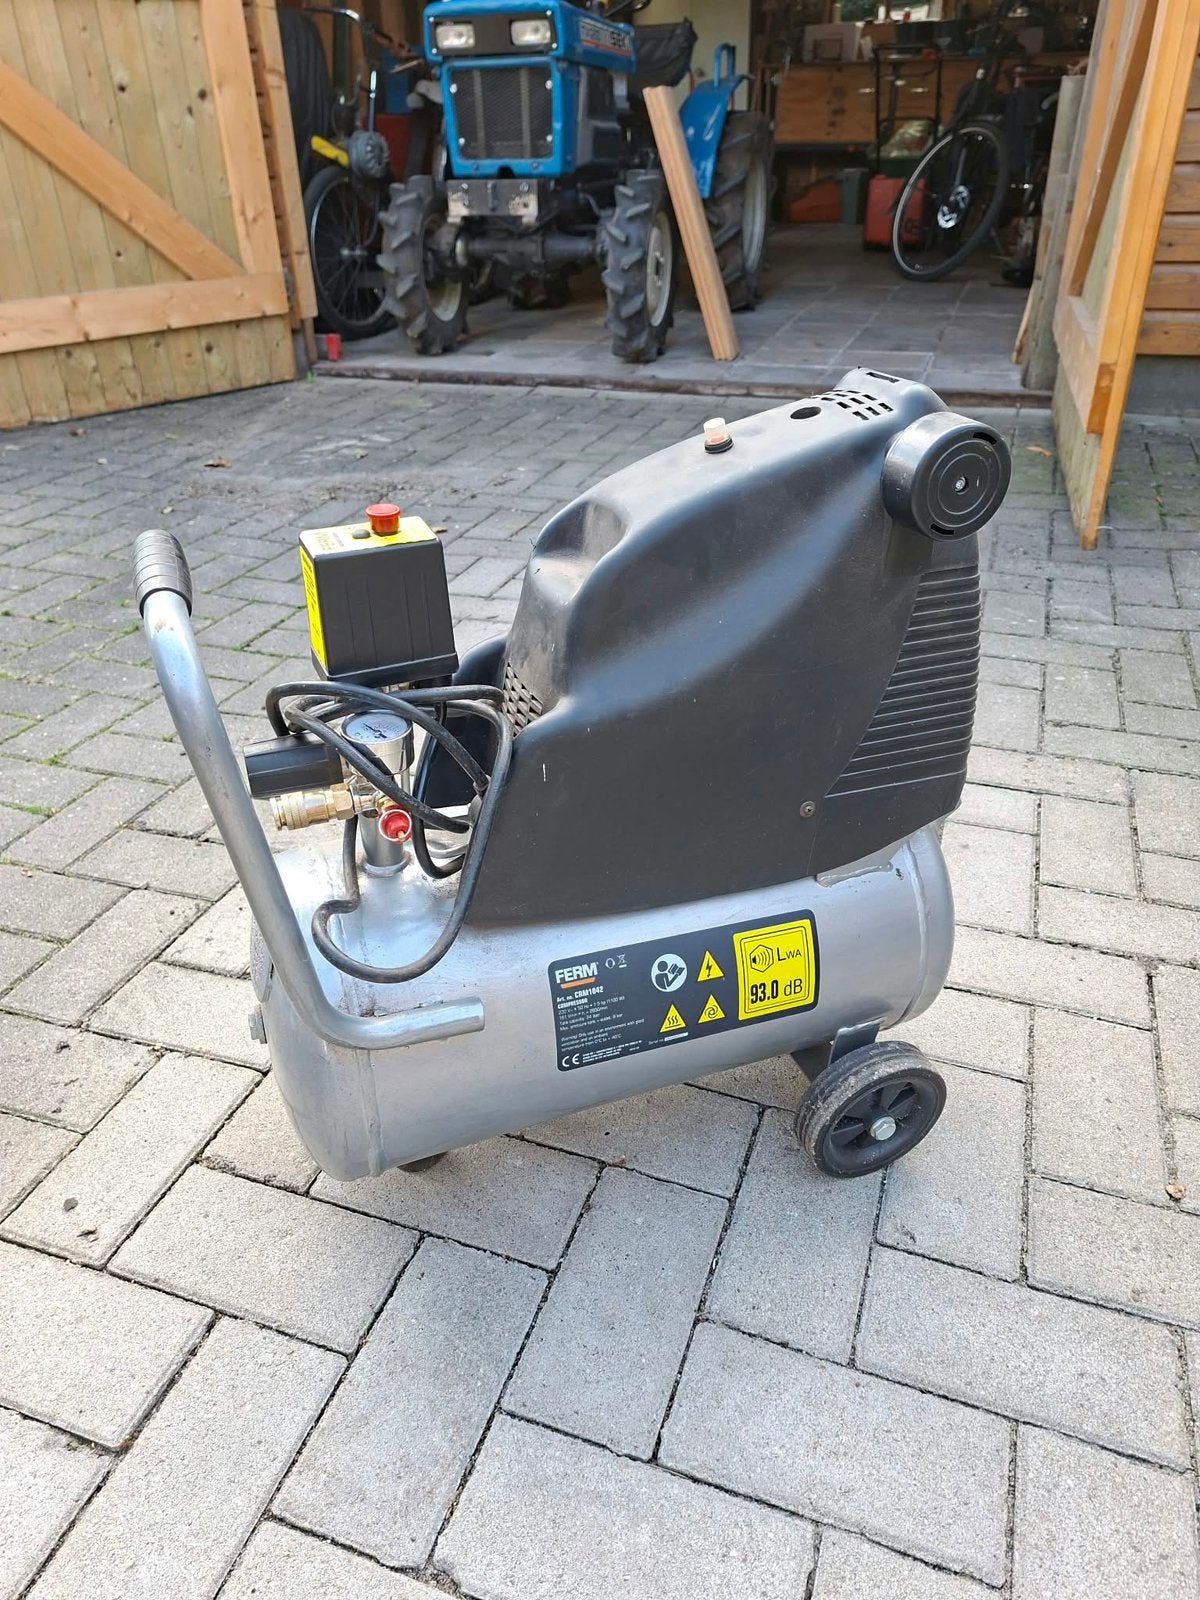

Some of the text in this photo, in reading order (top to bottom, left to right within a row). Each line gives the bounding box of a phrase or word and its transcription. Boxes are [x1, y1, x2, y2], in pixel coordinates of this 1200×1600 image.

[555, 962, 598, 984] FERM
[750, 978, 803, 1005] 93.0 dB
[557, 997, 588, 1010] COMPRESSOR
